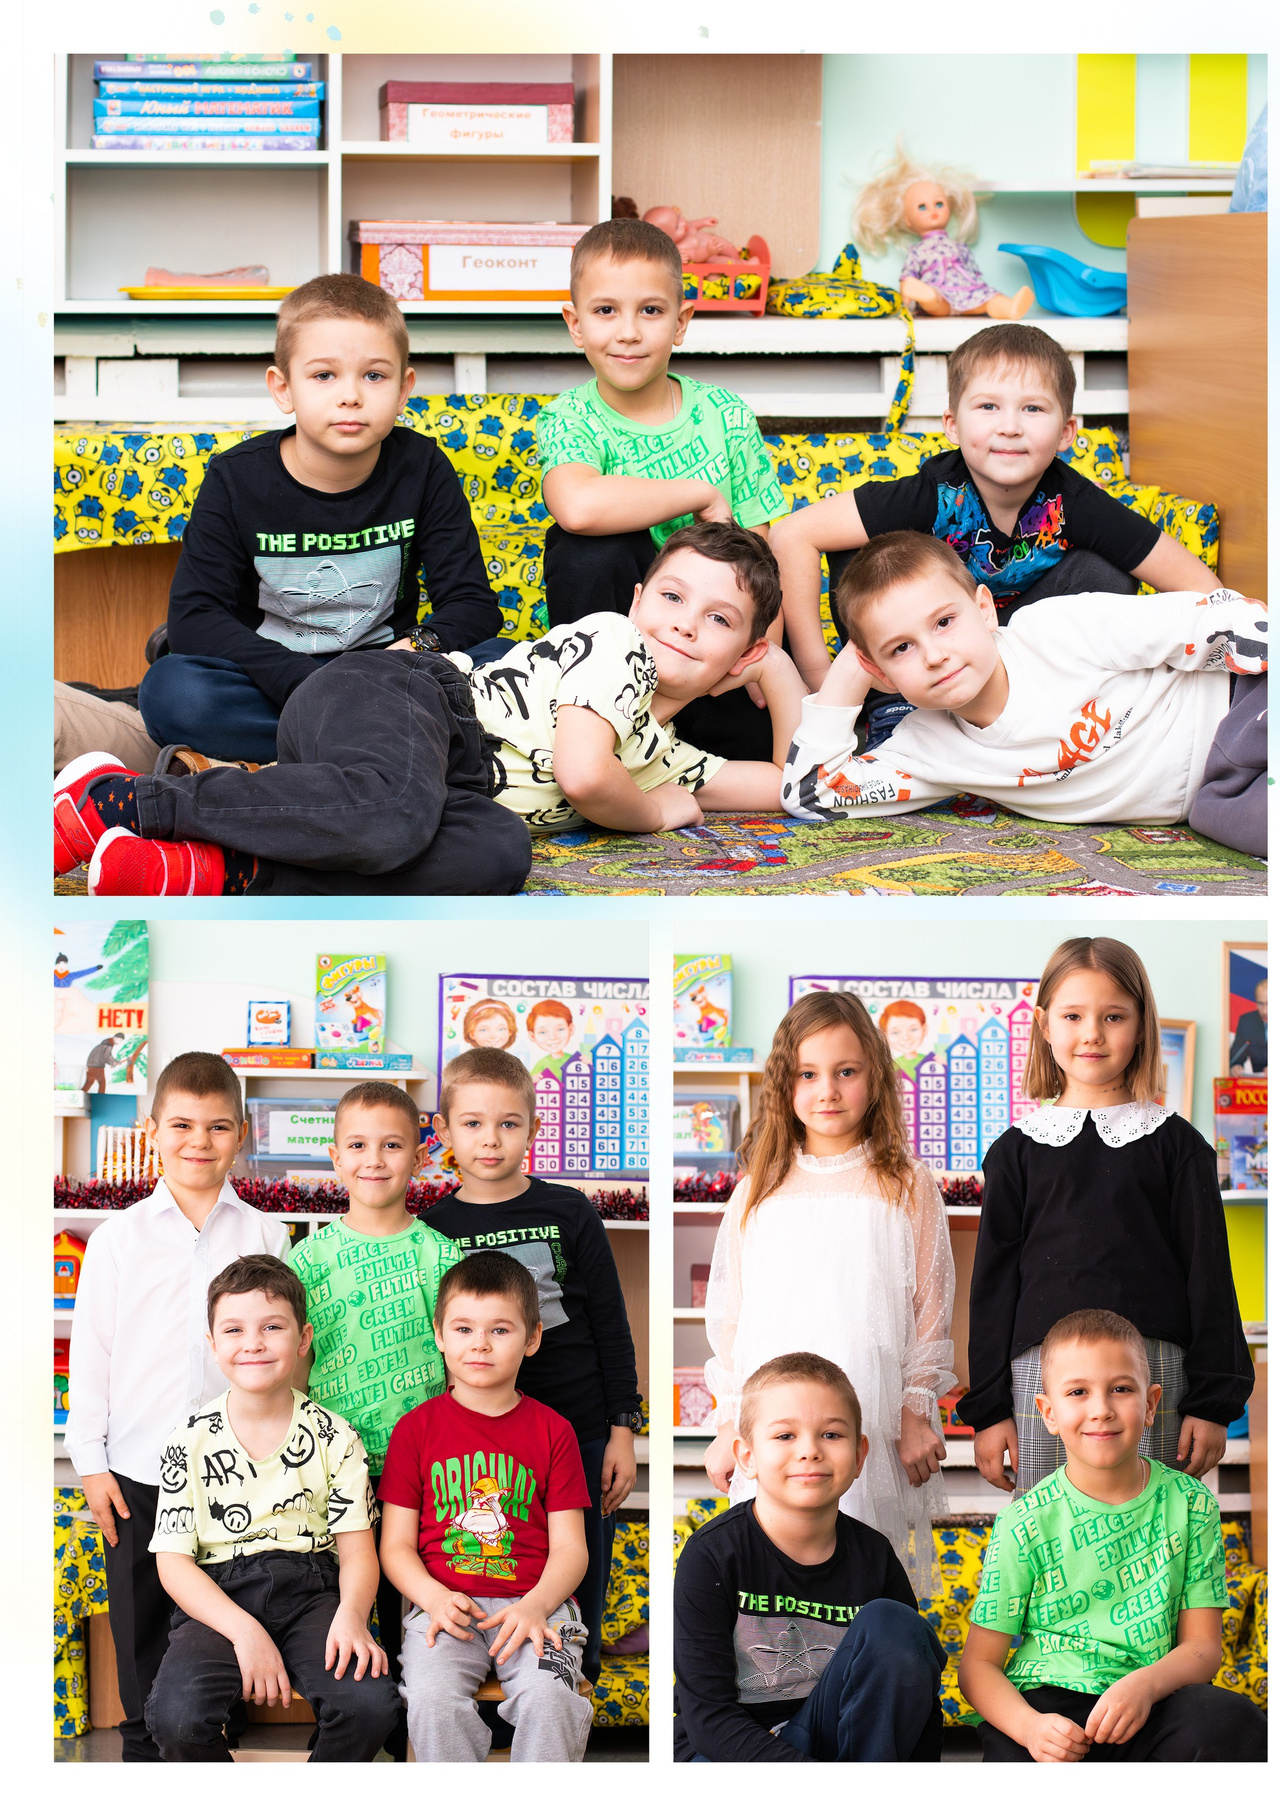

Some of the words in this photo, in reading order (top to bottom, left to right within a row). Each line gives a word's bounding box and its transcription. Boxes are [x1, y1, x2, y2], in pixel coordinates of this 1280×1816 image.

[194, 101, 294, 115] МАТЕМАТИК
[421, 108, 532, 120] Геометрические
[449, 128, 504, 140] фигуры
[462, 255, 539, 269] Геоконт
[255, 532, 297, 552] THE
[302, 518, 416, 552] POSITIVE
[833, 783, 896, 808] FASHION
[320, 955, 377, 990] ФИГУРЫ
[492, 980, 577, 997] СОСТАВ
[936, 982, 1013, 999] ЧИСЛА
[98, 1008, 145, 1029] НЕТ!
[475, 1225, 561, 1248] POSITIVE
[336, 1242, 390, 1270] PEACE
[368, 1268, 428, 1304] FUTURE
[359, 1295, 417, 1331] GREEN
[390, 1360, 437, 1395] GREEN
[431, 1451, 537, 1523] ORIGINAL
[1069, 1509, 1135, 1552] PEACE
[1116, 1530, 1185, 1594] FUTURE
[737, 1590, 770, 1612] THE
[1110, 1572, 1172, 1626] GREEN
